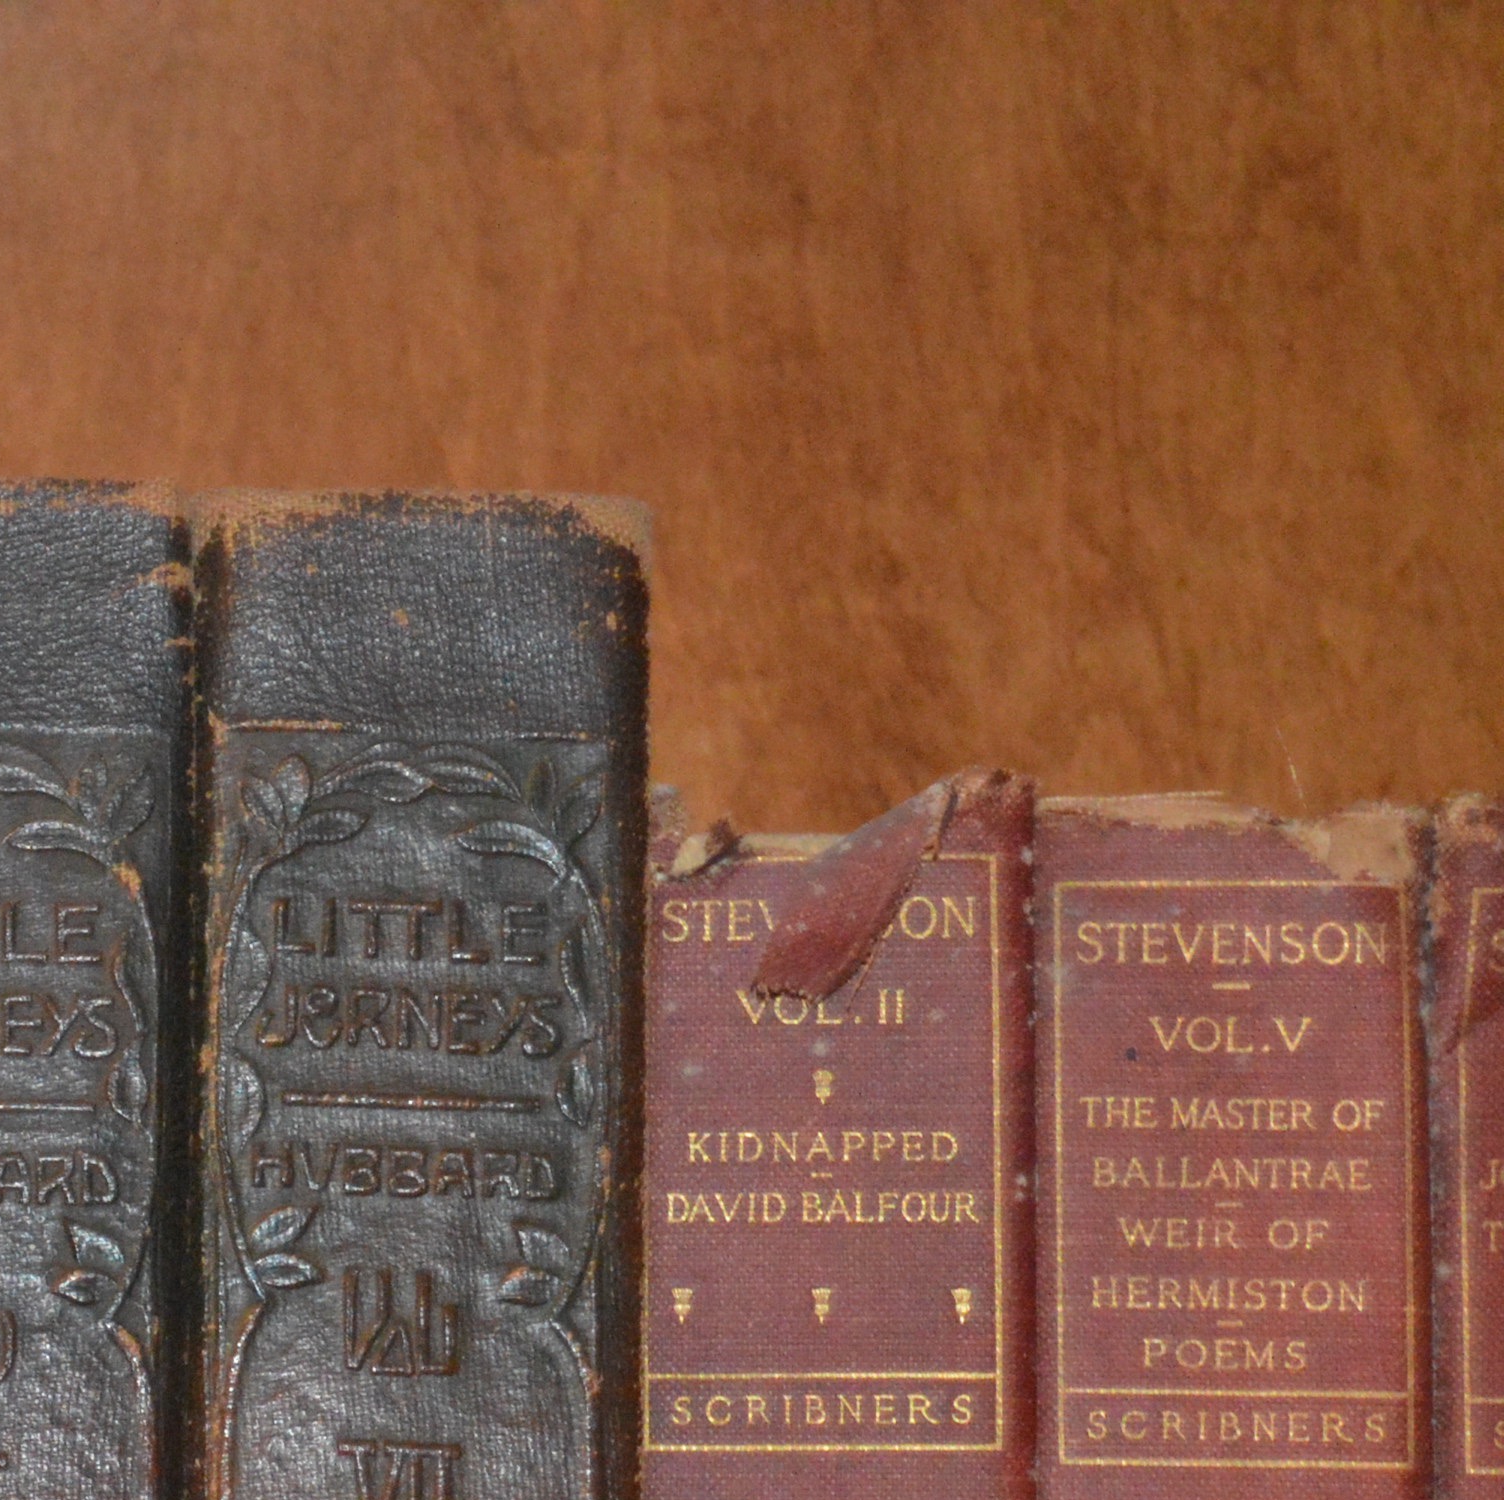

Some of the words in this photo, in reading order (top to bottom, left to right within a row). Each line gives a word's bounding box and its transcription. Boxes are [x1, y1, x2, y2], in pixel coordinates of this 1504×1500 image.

[274, 901, 547, 965] LITTLE
[662, 896, 977, 942] STEON
[1077, 921, 1387, 965] STEVENSON
[1079, 1097, 1158, 1129] THE
[1170, 1097, 1317, 1130] MASTER
[1332, 1099, 1386, 1131] OF
[688, 1131, 959, 1163] KIDNAPPED
[1093, 1156, 1372, 1190] BALLANTRAE
[666, 1191, 787, 1224] DAVID
[800, 1190, 980, 1224] BALFOUR
[1118, 1217, 1240, 1249] WEIR
[1268, 1219, 1330, 1250] OF
[1092, 1276, 1367, 1312] HERMISTON
[1144, 1338, 1308, 1371] POEMS
[672, 1394, 972, 1426] SCRIBNERS
[1087, 1410, 1387, 1444] SCRIBNERS
